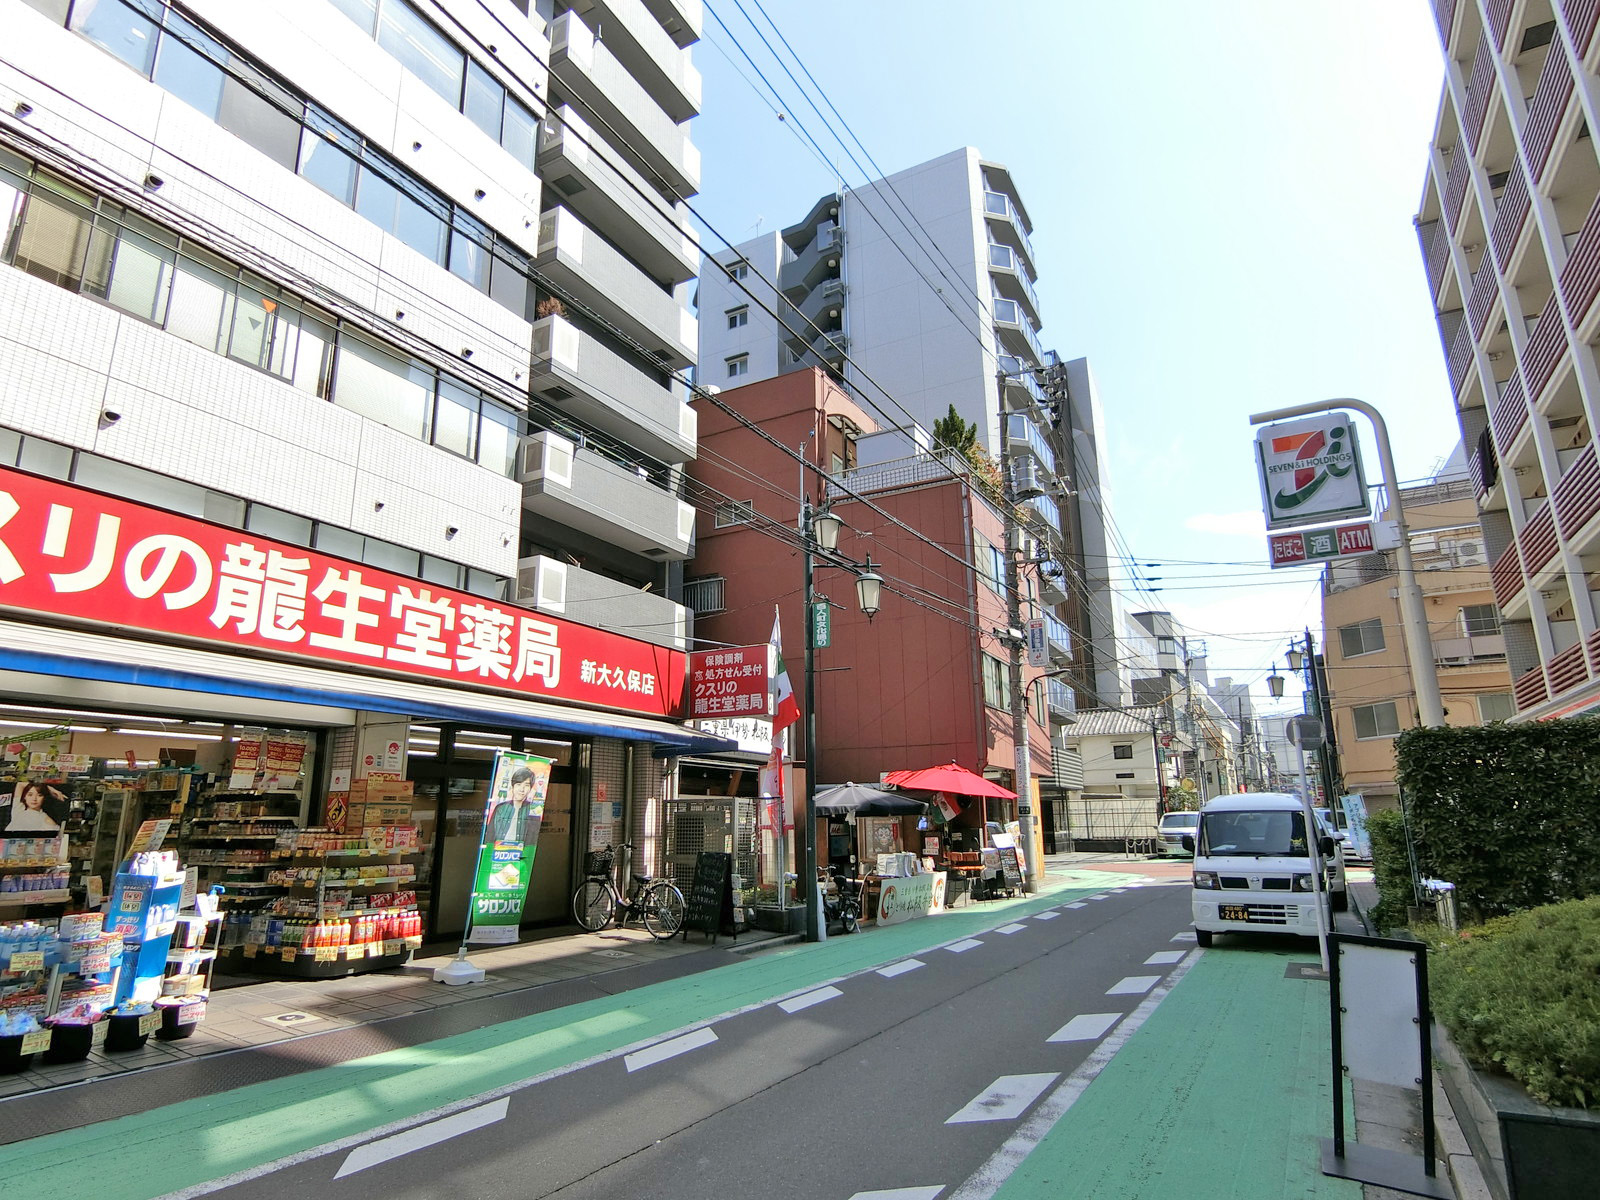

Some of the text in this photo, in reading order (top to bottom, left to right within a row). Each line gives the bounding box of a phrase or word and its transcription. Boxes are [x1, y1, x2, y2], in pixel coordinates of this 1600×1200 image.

[1307, 452, 1352, 467] HOLDINGS
[1273, 529, 1371, 559] たばこ 酒 ATM
[705, 652, 744, 667] 保険調剤
[580, 659, 656, 697] 新大久保店
[705, 664, 763, 681] 処方せん受付
[694, 680, 738, 697] クスリの
[694, 693, 764, 714] 龍生堂薬局
[478, 898, 522, 914] サロンパス
